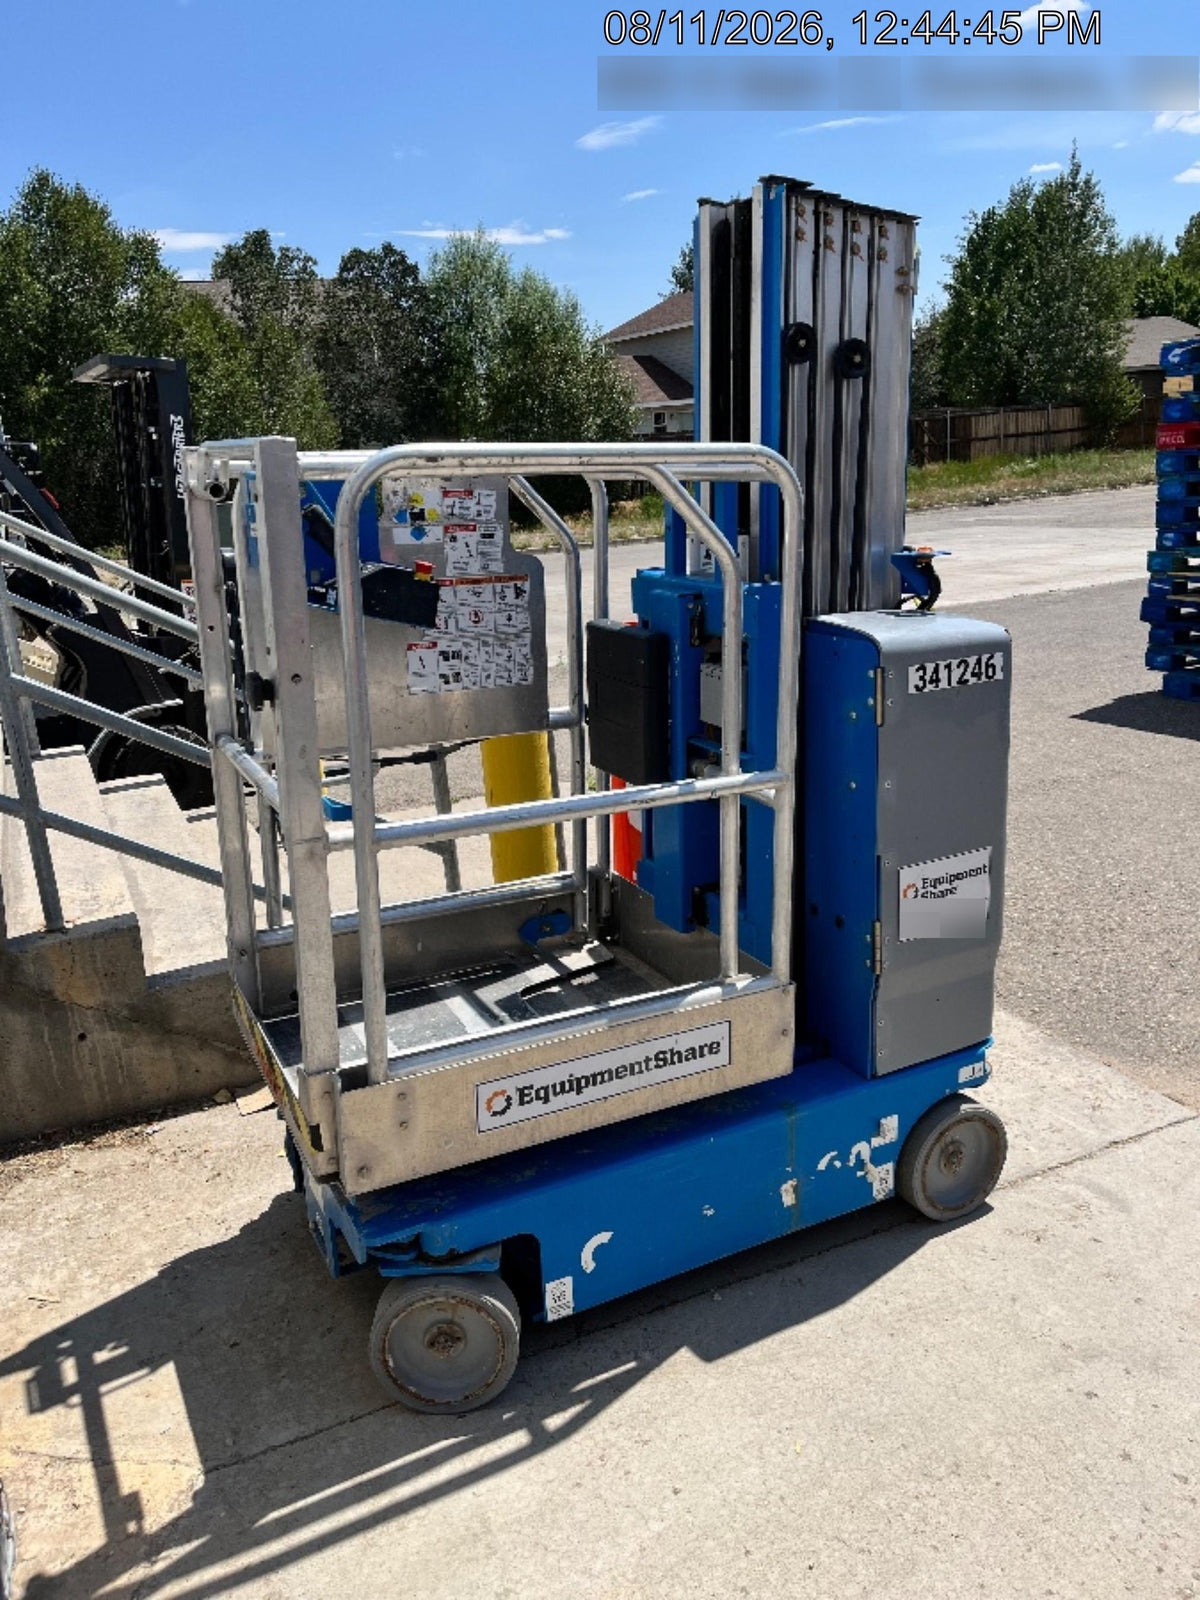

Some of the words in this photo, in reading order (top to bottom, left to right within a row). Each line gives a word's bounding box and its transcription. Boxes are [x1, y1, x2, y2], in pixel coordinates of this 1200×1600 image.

[914, 654, 996, 692] 341246
[921, 863, 988, 889] Equipment
[516, 1040, 721, 1106] EquipmentShare
